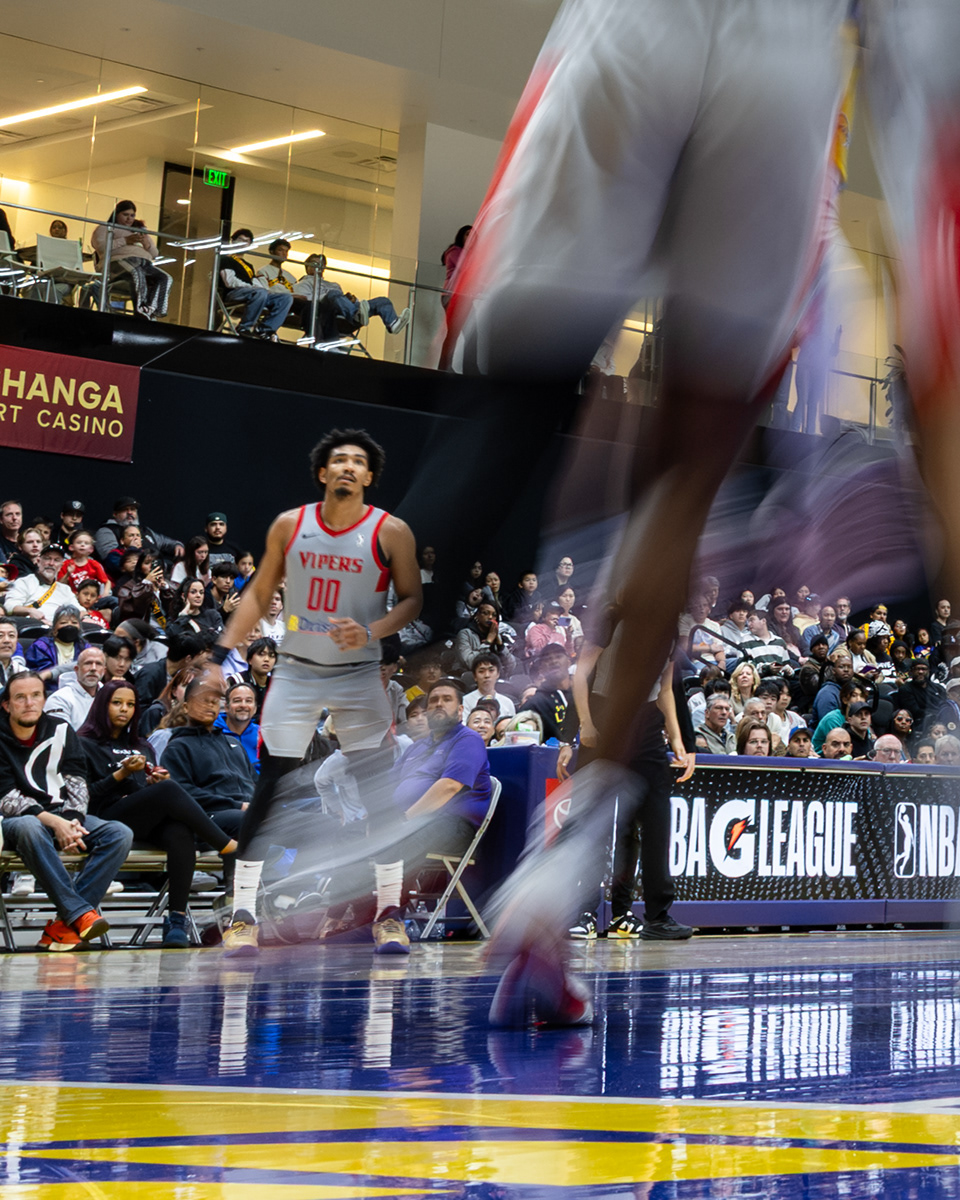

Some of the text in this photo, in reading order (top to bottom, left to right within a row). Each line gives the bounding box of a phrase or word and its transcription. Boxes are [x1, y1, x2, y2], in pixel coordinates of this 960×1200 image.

[208, 169, 227, 186] EXIT
[37, 409, 123, 438] CASINO
[299, 551, 364, 574] VIPERS
[307, 576, 342, 613] 00
[669, 797, 858, 878] BA G LEAGUE
